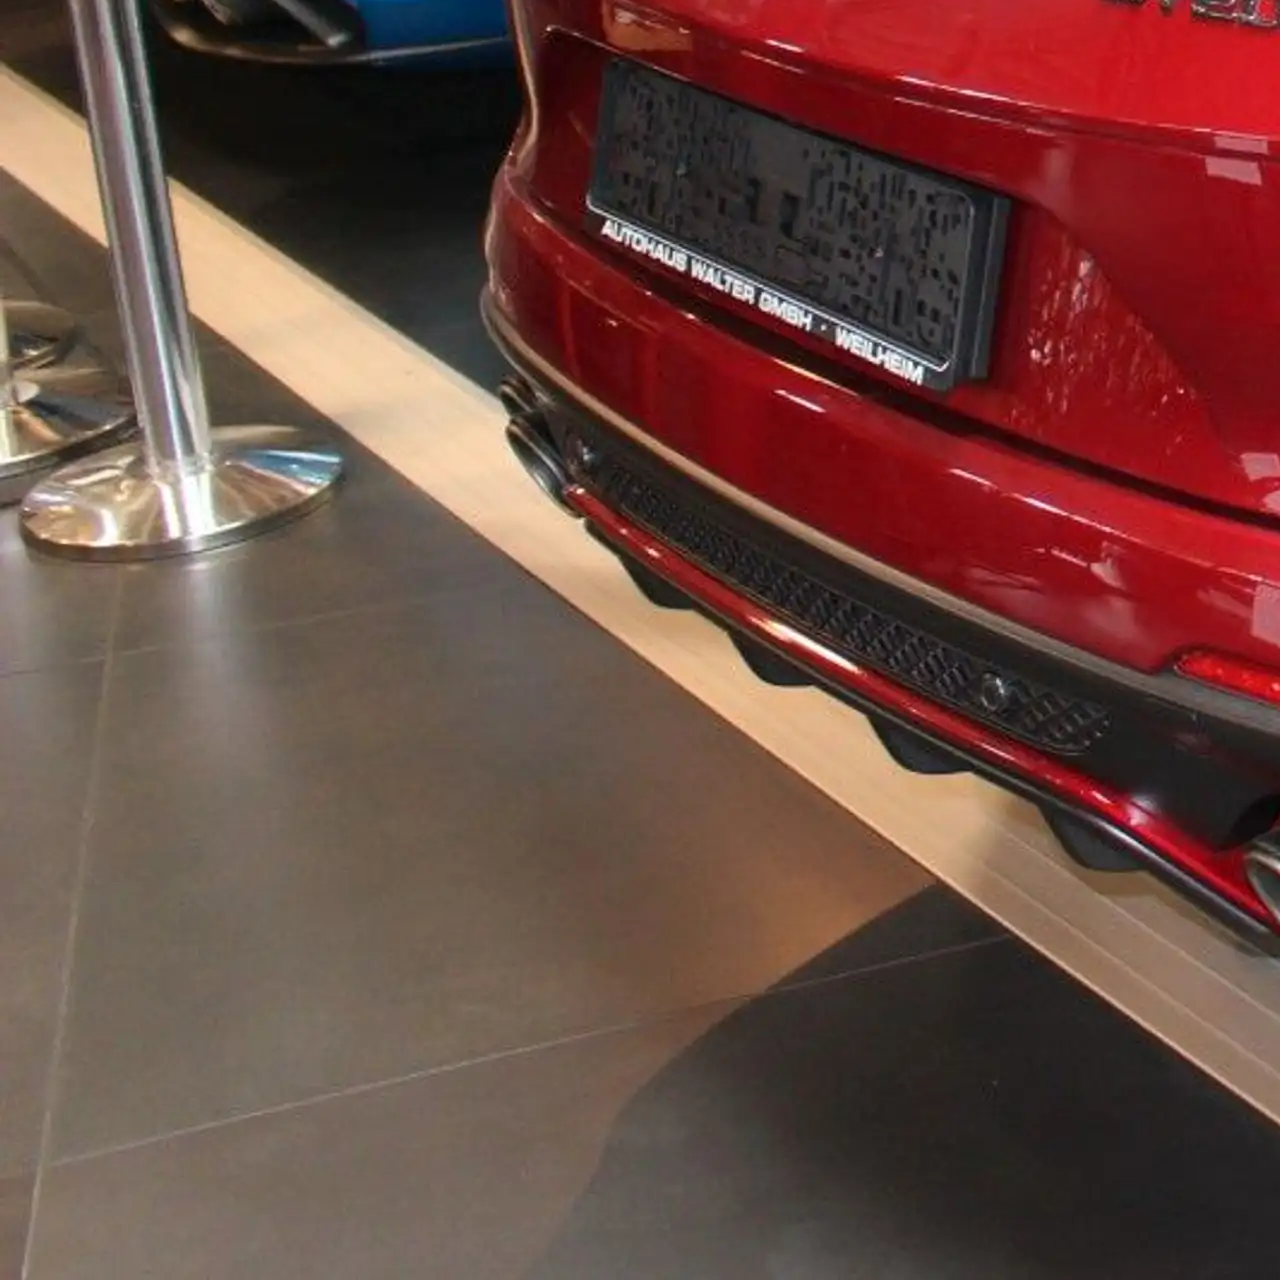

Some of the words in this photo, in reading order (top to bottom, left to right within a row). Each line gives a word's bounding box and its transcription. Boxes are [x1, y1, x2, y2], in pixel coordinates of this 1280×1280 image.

[601, 219, 688, 273] AUTOHAUS
[690, 258, 755, 306] WALTER
[834, 326, 926, 387] WEILHEIM
